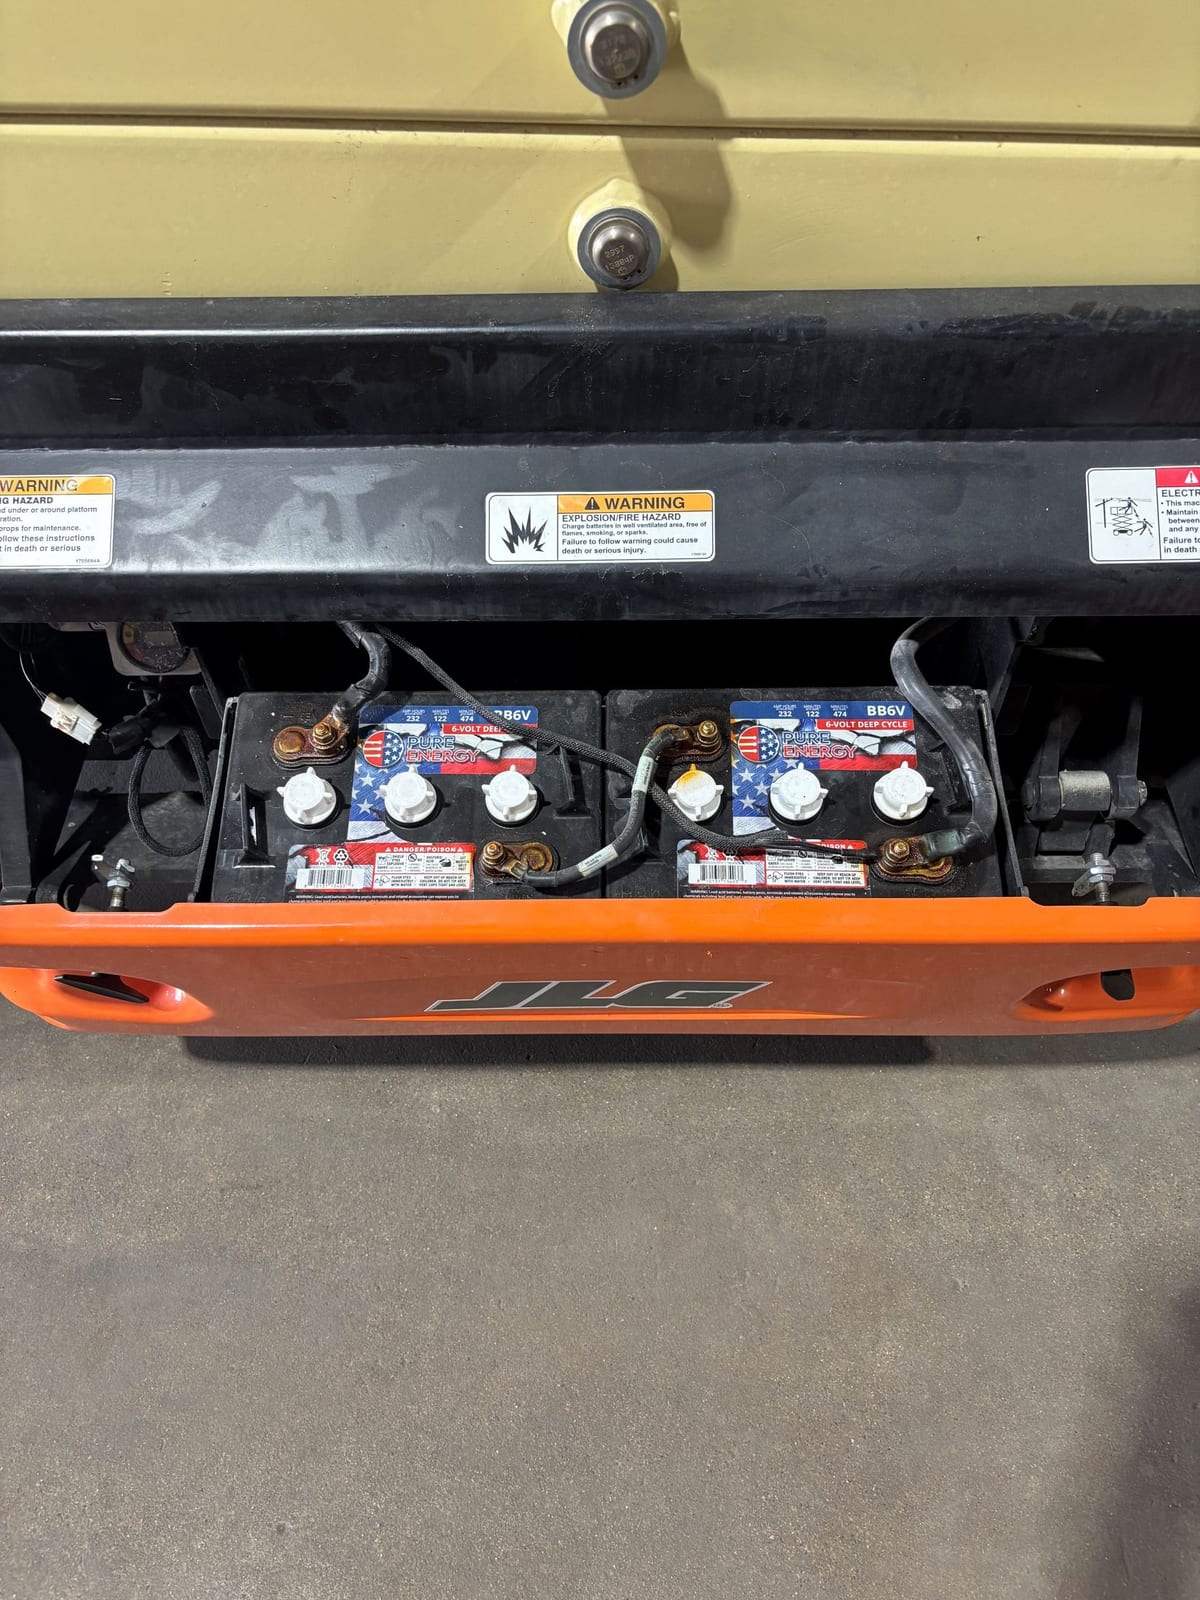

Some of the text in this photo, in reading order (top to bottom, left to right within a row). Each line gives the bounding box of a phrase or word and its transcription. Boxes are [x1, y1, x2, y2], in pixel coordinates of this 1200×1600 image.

[0, 479, 78, 492] WARNING
[605, 497, 685, 510] WARNING
[562, 514, 639, 522] EXPLOSION/FIRE
[867, 706, 906, 716] BB6V
[408, 737, 455, 749] PURE
[782, 732, 832, 745] PURE
[406, 750, 480, 763] ENERGY
[783, 745, 857, 759] ENERGY
[424, 980, 773, 1012] JLG
